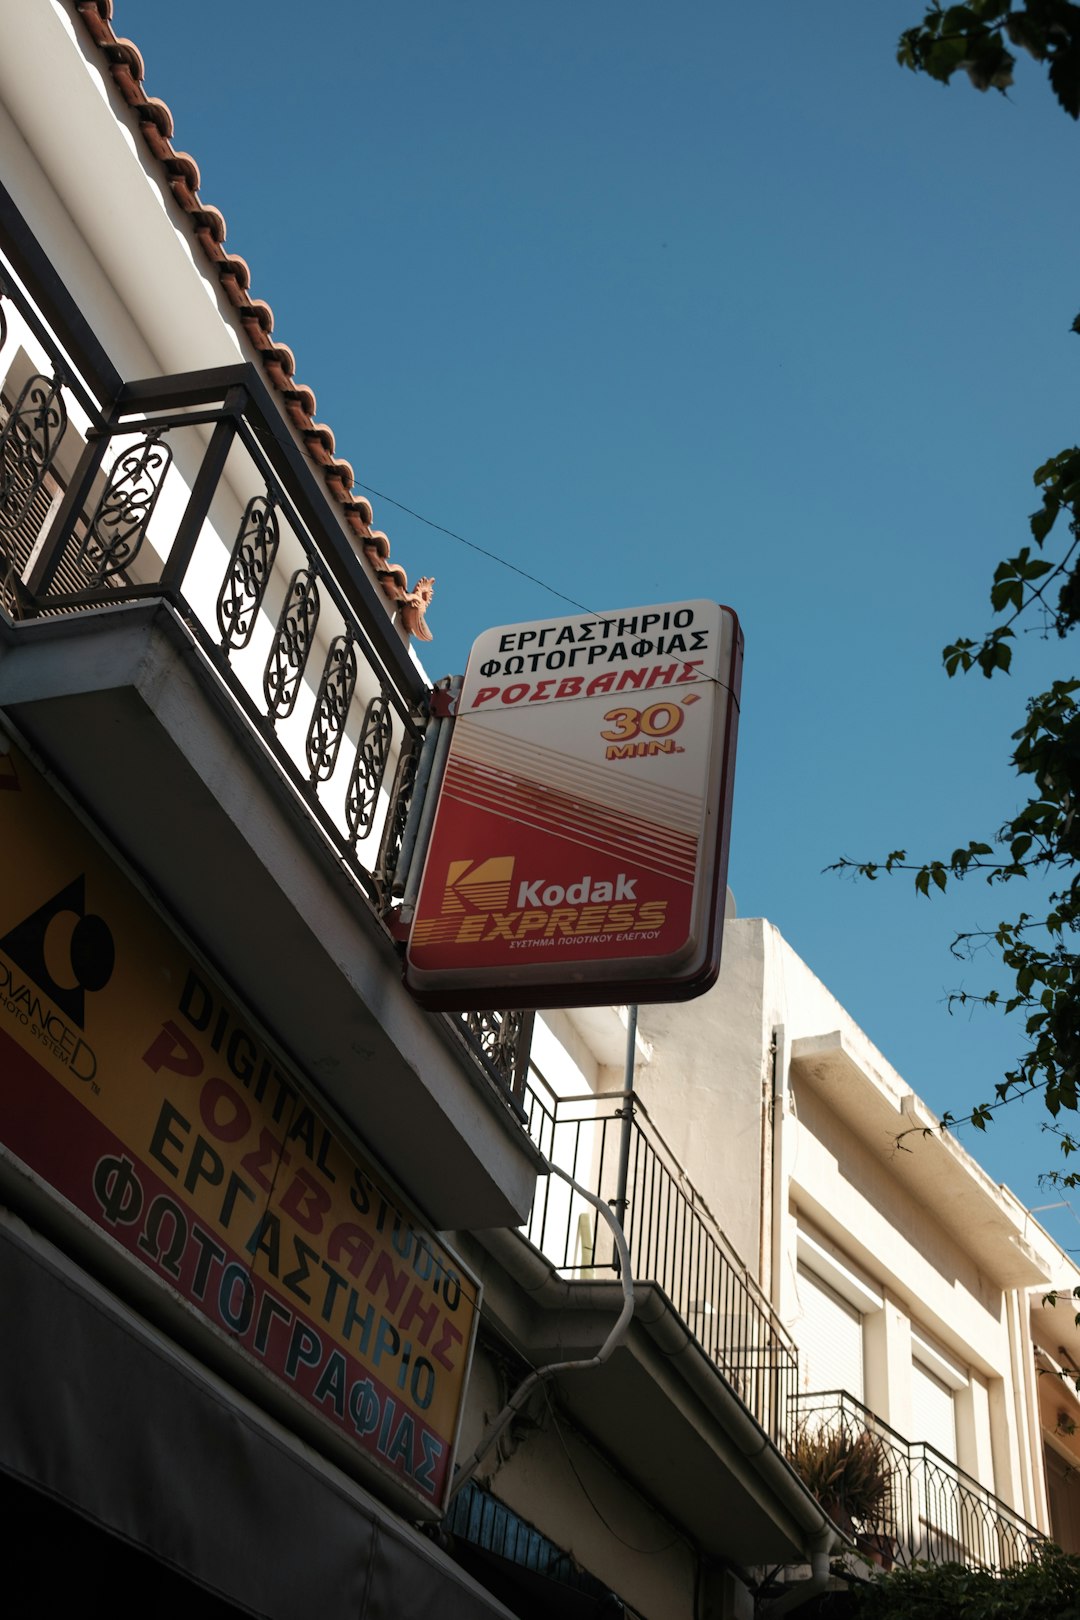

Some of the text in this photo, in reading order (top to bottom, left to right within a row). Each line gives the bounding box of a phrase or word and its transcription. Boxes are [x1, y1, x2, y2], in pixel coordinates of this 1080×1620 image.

[499, 609, 694, 652] ΕΡΓΑΣΤΗΡΙΟ
[480, 630, 709, 677] ΦΩΤΟΓΡΑΦΙΑΣ
[471, 660, 704, 708] ΡΟΣΒΑΝΗΣ
[605, 739, 685, 760] MIN.
[516, 873, 638, 909] Kodak
[455, 901, 668, 943] EXPRESS
[509, 930, 661, 949] ΣΥΣΤΗΜΑ ΠΟΙΟΤΙΚΟΥ ΕΛΕΓΧΟΥ
[30, 1023, 69, 1066] SYSTEM
[178, 969, 461, 1311] DIGITAL STUDIO
[142, 1019, 464, 1372] ΡΟΣΒΑΝΗΣ
[149, 1098, 436, 1410] ΕΡΓΑΣΤΗΡΙΟ
[92, 1153, 443, 1496] ΦΩΤΟΓΡΑΦΙΑΣ
